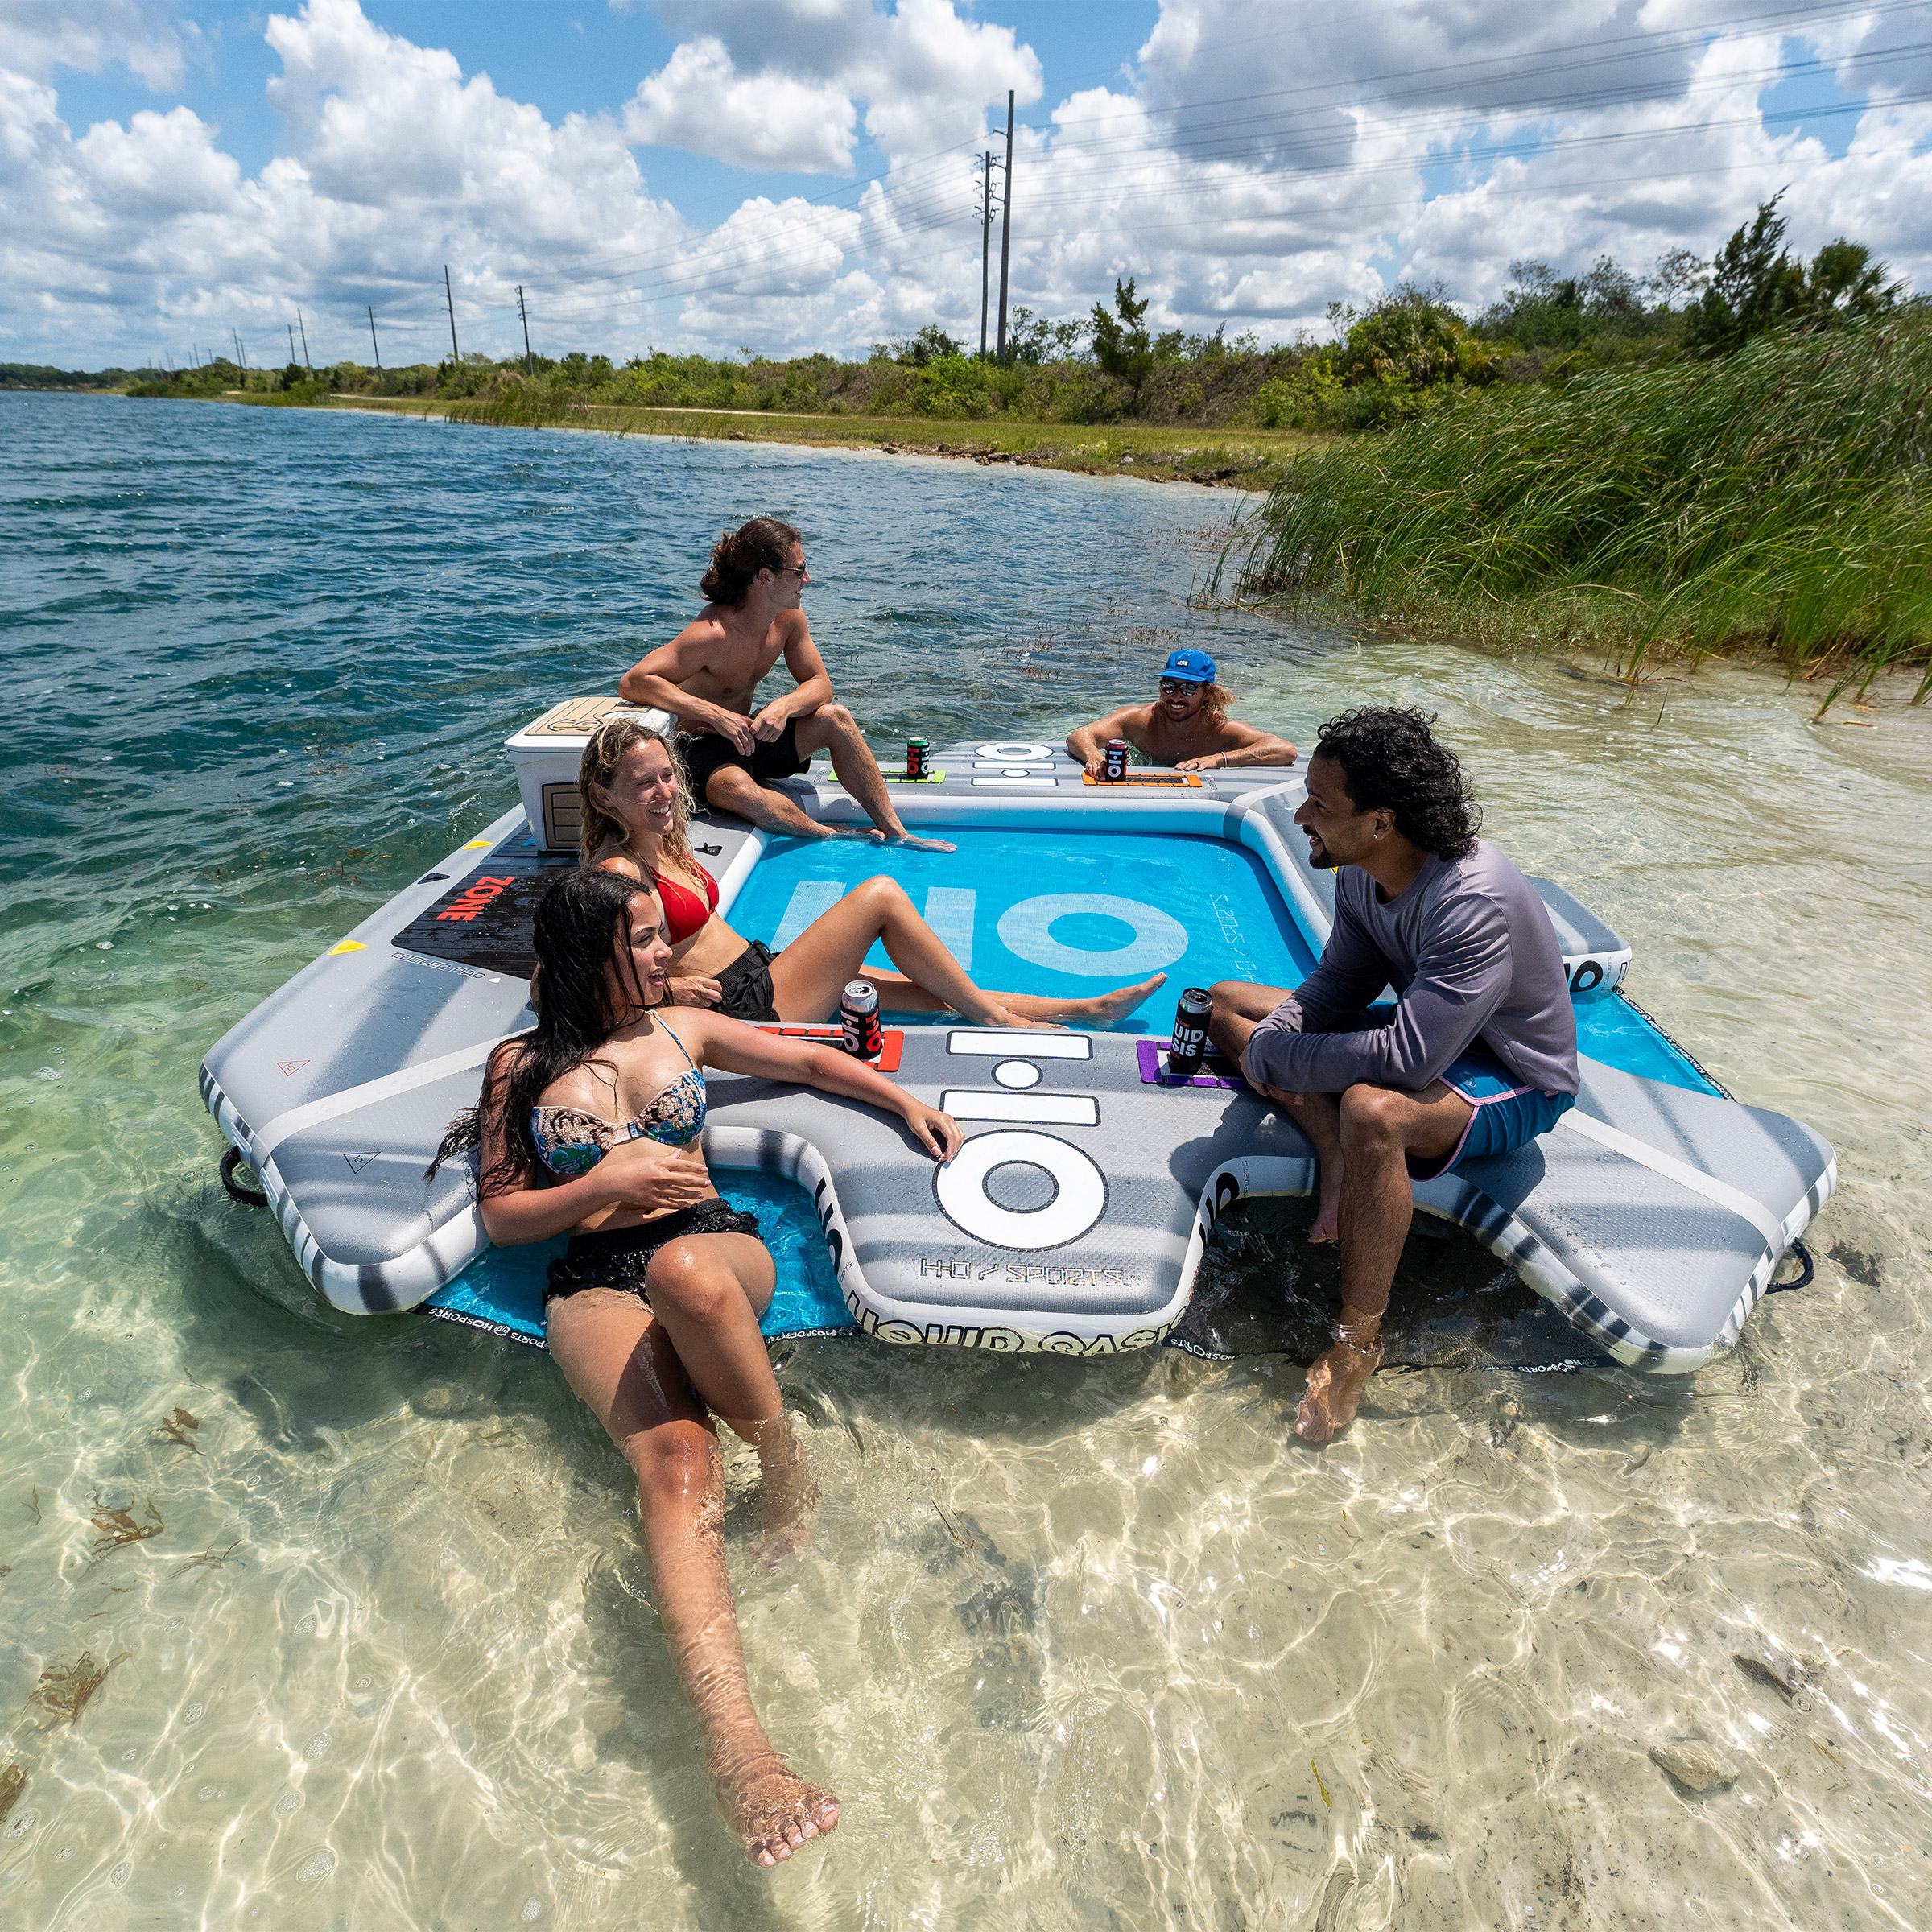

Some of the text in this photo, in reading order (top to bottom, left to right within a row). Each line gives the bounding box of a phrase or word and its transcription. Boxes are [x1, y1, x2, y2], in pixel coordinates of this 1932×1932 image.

[436, 877, 515, 921] ZONE
[449, 966, 485, 979] PAD
[920, 1258, 971, 1279] HO
[1006, 1264, 1124, 1286] SPORTS
